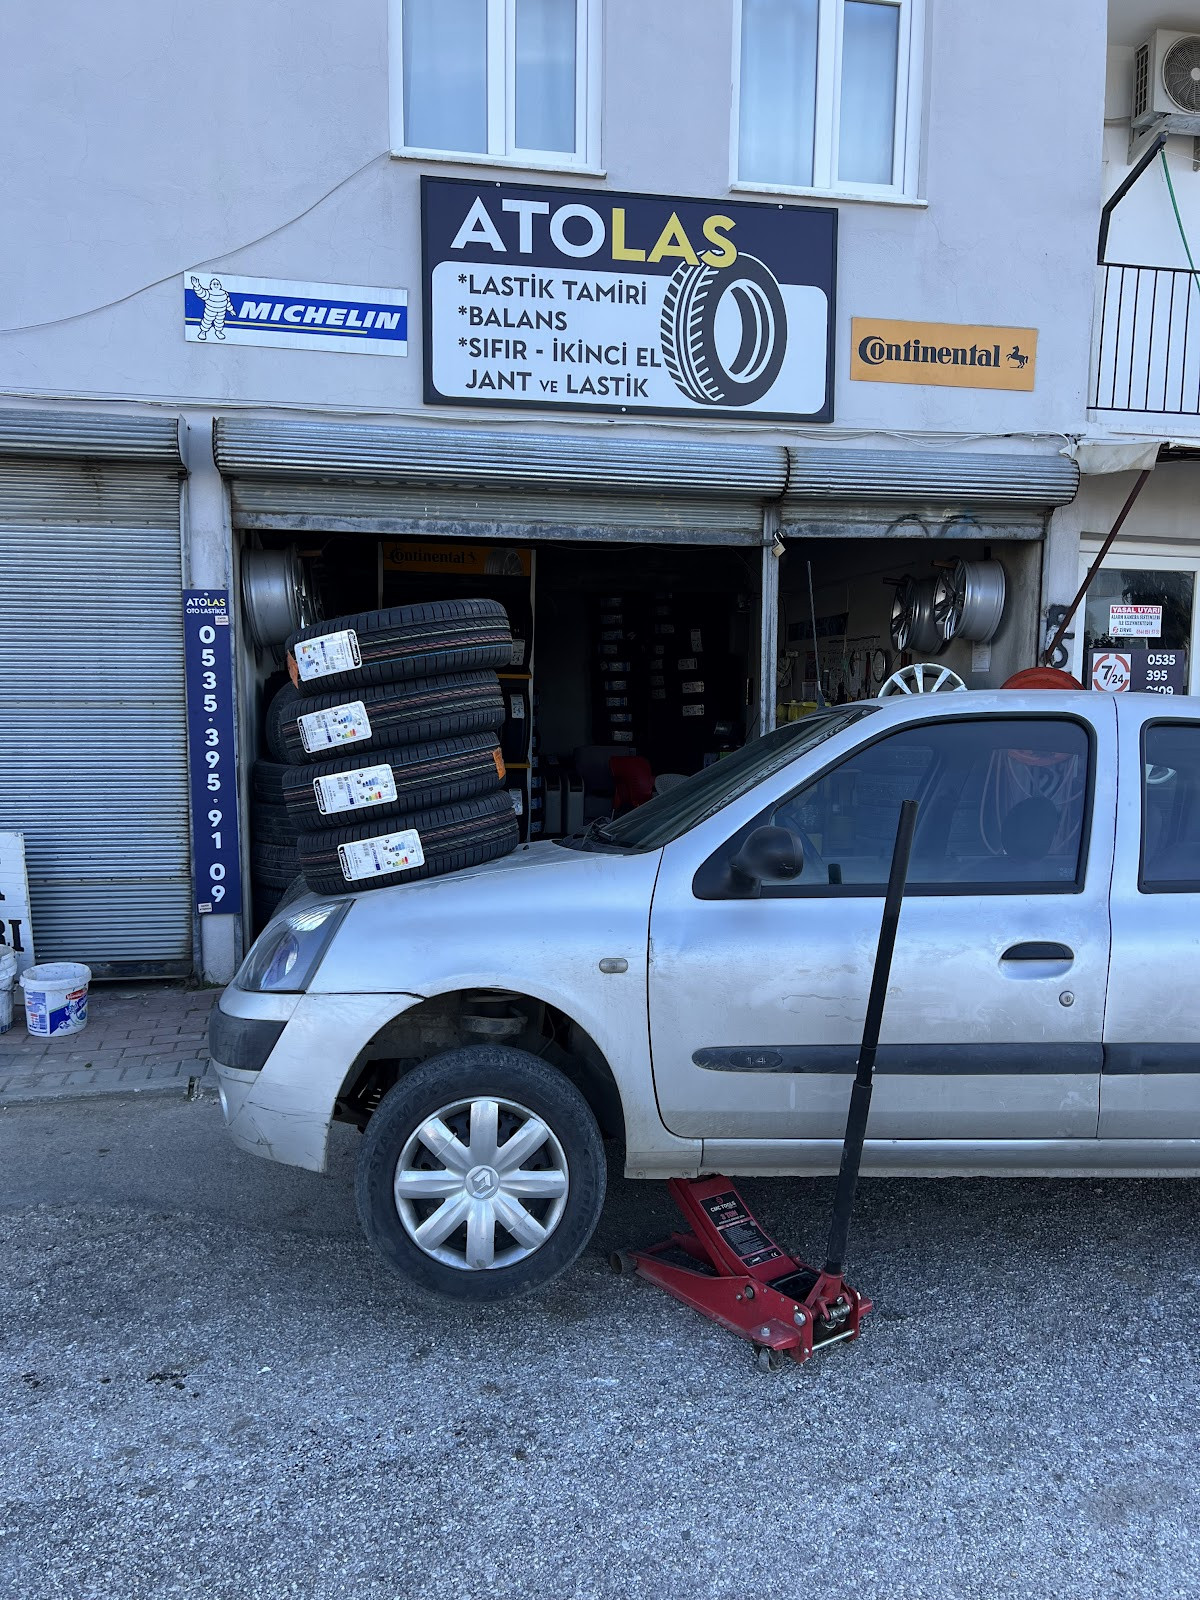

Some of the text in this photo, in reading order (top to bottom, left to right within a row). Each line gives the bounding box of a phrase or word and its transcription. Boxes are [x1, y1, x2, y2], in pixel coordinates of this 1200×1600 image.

[450, 195, 739, 268] ATOLAS
[562, 280, 648, 305] TAMİRİ
[238, 301, 401, 330] MICHELIN
[553, 338, 628, 367] İKİNCİ
[637, 349, 662, 368] EL
[858, 335, 1000, 368] Continental
[465, 370, 532, 392] JANT
[566, 372, 649, 398] LASTİK
[389, 547, 465, 564] Continental
[186, 598, 226, 606] ATOLAS
[1147, 654, 1176, 665] 0535
[1146, 670, 1168, 681] 395
